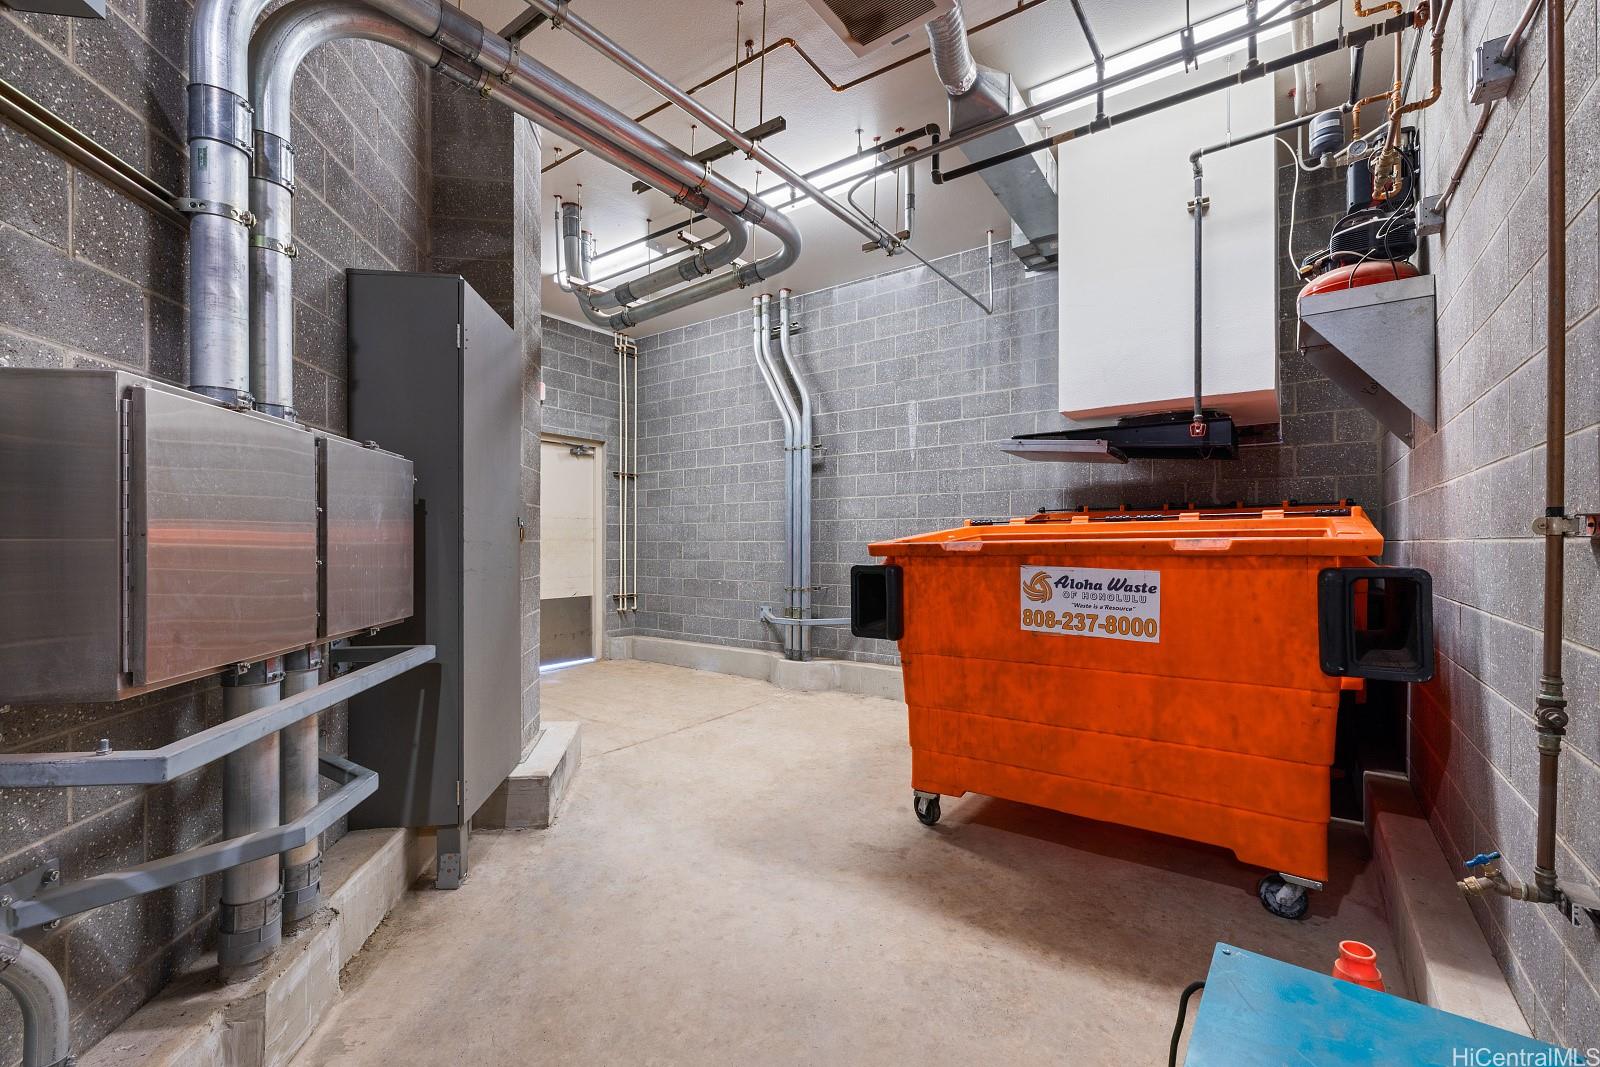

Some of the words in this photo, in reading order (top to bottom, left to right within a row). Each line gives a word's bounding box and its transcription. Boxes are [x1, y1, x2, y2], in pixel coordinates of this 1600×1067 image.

[1054, 575, 1102, 591] Aloha
[1107, 577, 1158, 594] Waste
[1062, 591, 1077, 599] OF
[1081, 592, 1147, 603] HONOLULU
[1023, 608, 1157, 638] 808-237-8000
